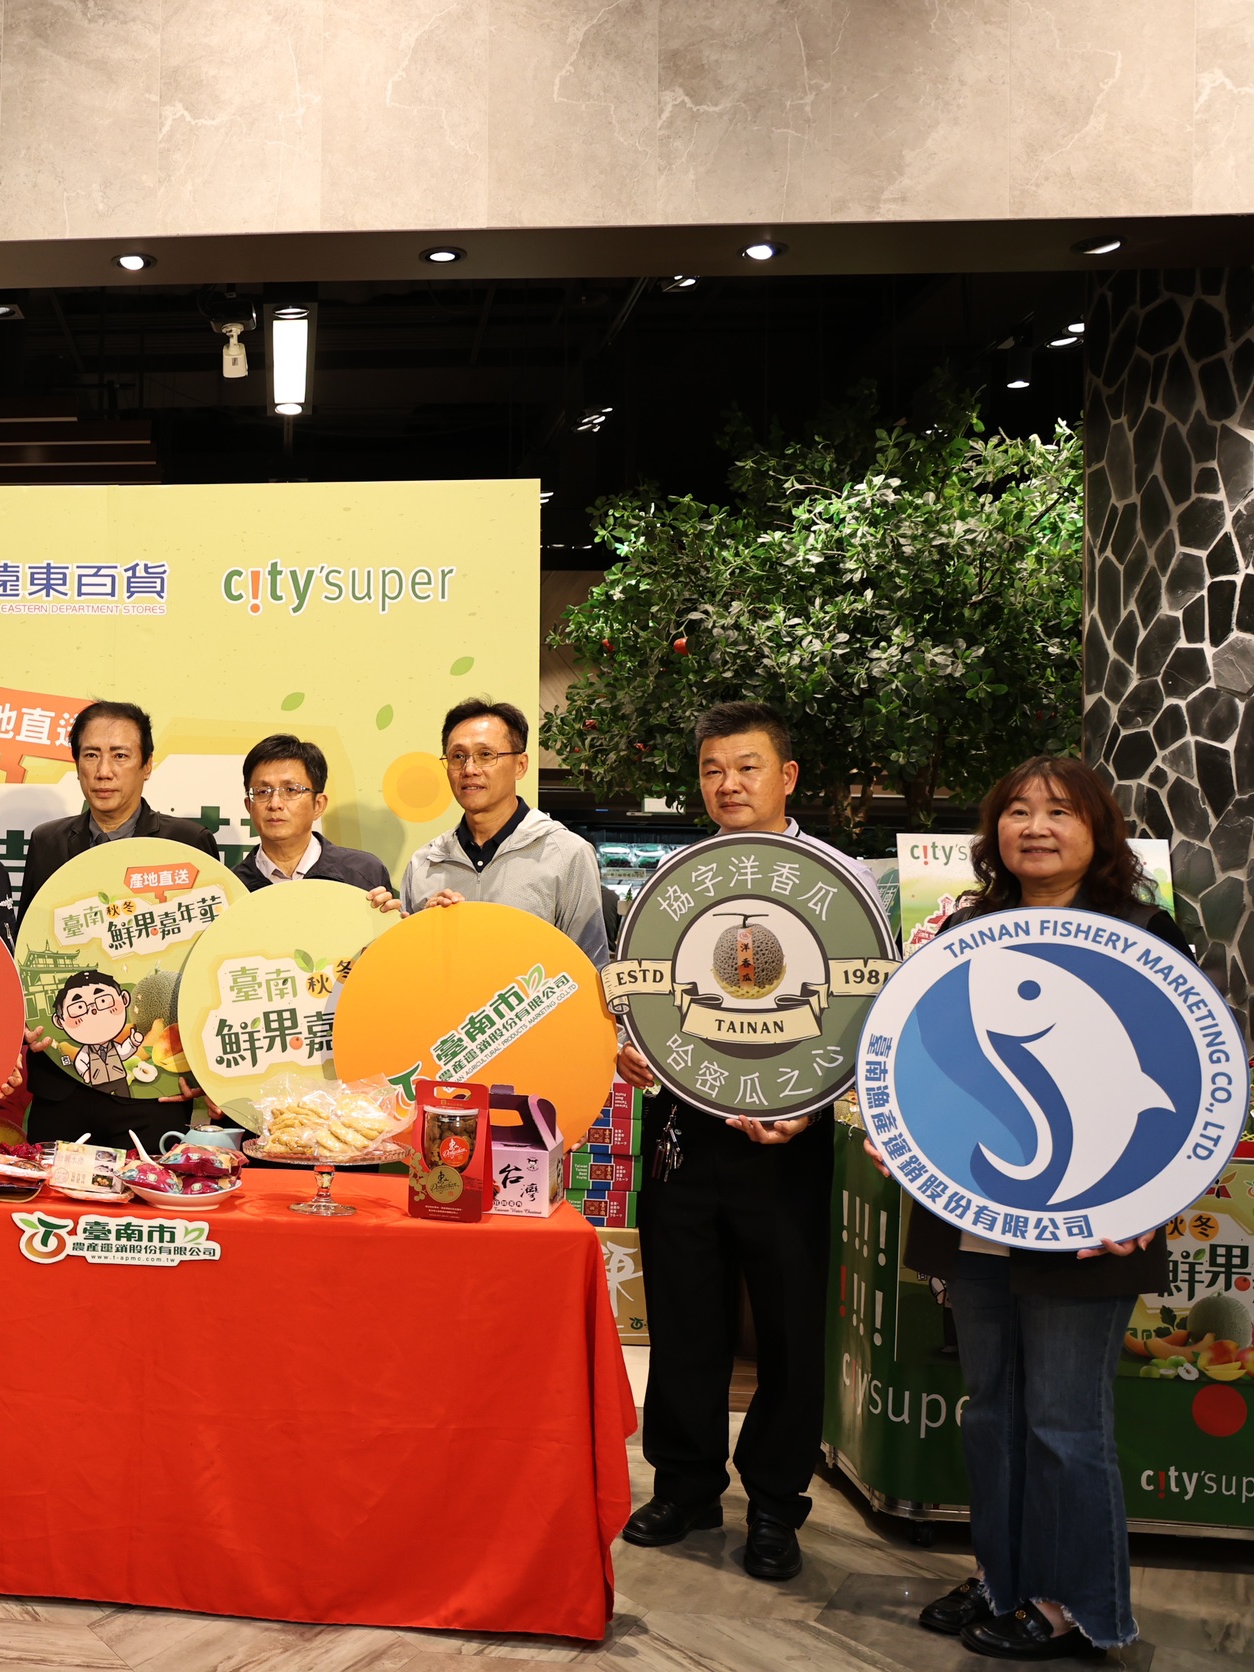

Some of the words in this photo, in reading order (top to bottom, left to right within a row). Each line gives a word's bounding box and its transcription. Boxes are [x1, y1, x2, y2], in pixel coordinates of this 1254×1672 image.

[1, 604, 48, 613] EASTERN
[51, 604, 120, 614] DEPARTMENT
[123, 605, 166, 614] STORES
[129, 869, 189, 889] 產地直送
[657, 854, 838, 922] 協字洋香瓜
[107, 895, 224, 950] 鮮果嘉年華
[229, 966, 298, 1002] 臺南
[616, 968, 664, 986] ESTD
[843, 968, 890, 985] 1981
[433, 985, 525, 1066] 臺南市
[438, 974, 571, 1083] 農產運銷股份有限公司
[465, 1046, 502, 1076] AGRICULTURAL
[501, 1023, 529, 1047] PRODUCTS
[528, 1000, 557, 1025] MARKETING
[714, 1018, 785, 1035] TAINAN
[943, 920, 1032, 960] TAINAN
[1039, 919, 1138, 955] FISHERY
[1136, 947, 1233, 1065] MARKETING
[1186, 1120, 1226, 1162] LTD.
[665, 1034, 845, 1107] 哈密瓜之心
[864, 1032, 1095, 1242] 臺南漁產運銷股份有限公司
[72, 1241, 216, 1258] 農產運銷股份有限公司
[82, 1220, 177, 1244] 臺南市
[90, 1254, 176, 1263] www.t-apmc.com.tw
